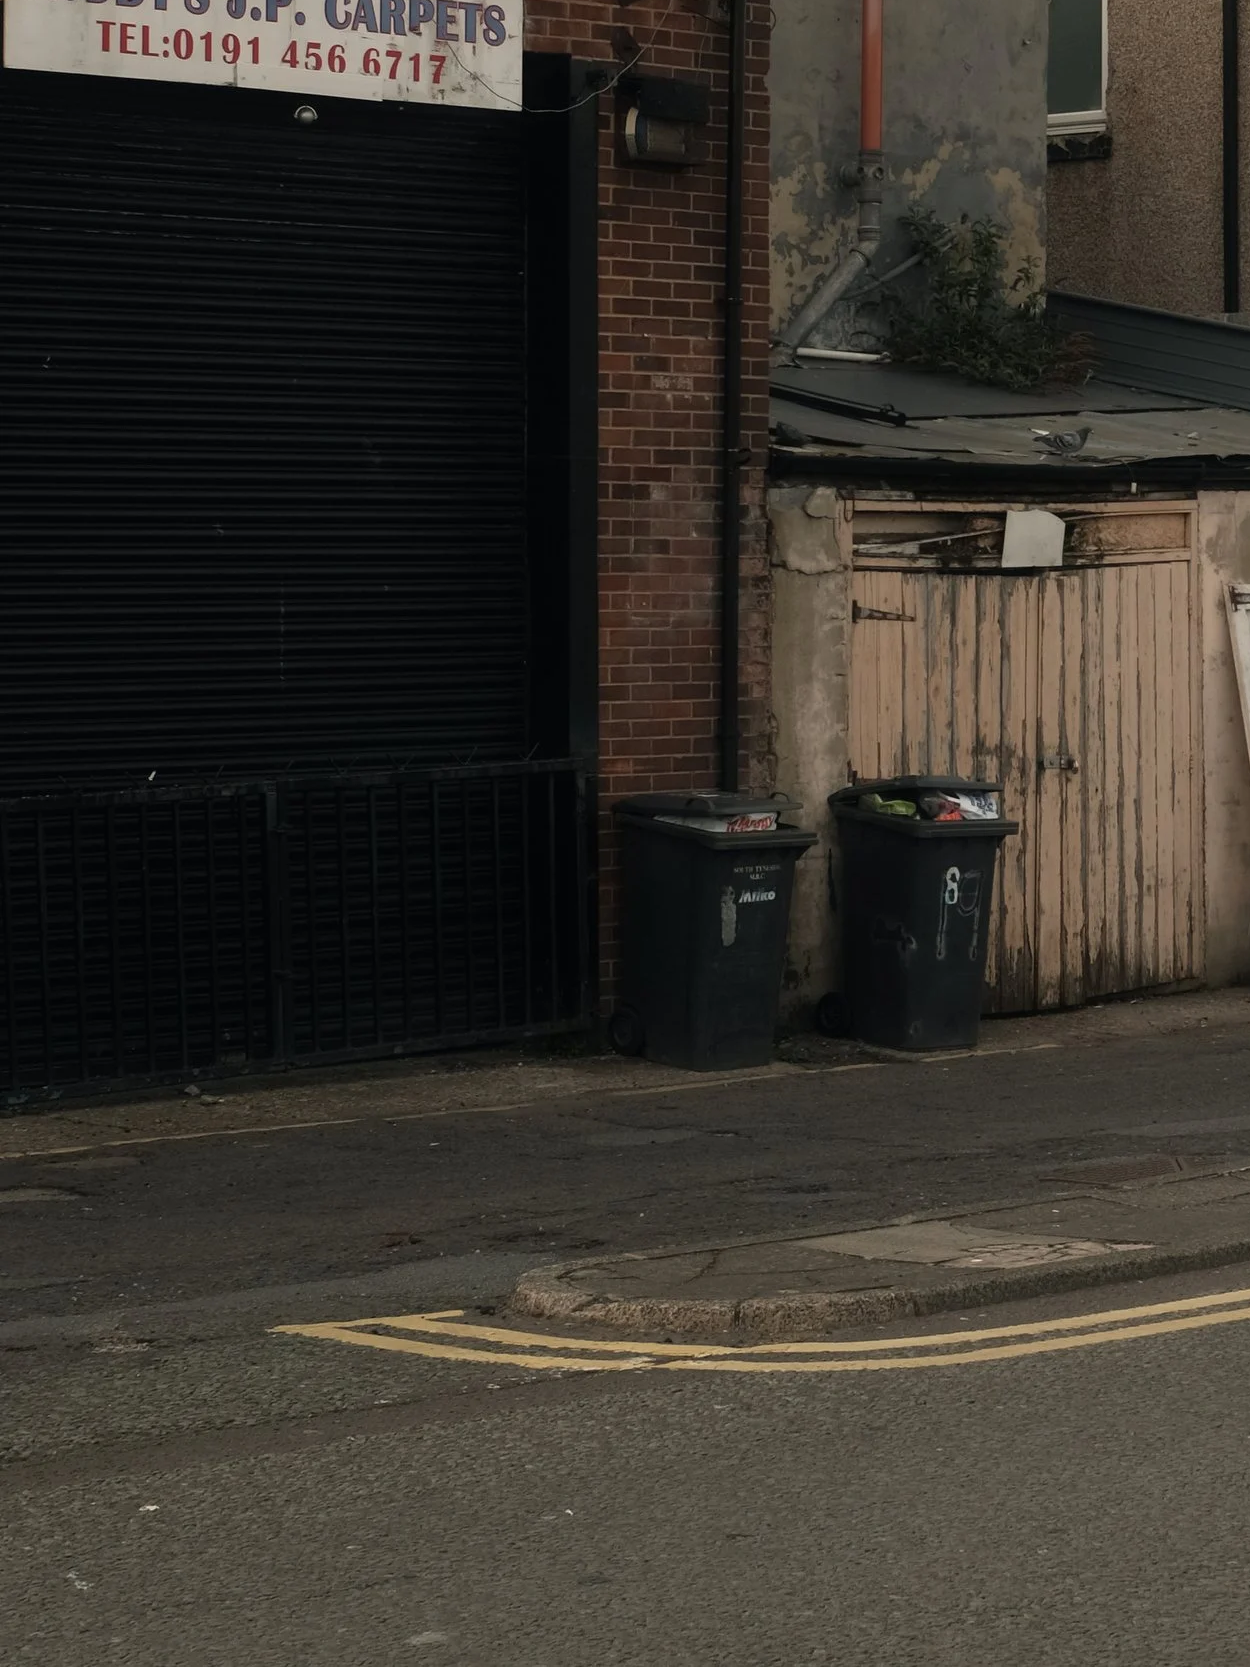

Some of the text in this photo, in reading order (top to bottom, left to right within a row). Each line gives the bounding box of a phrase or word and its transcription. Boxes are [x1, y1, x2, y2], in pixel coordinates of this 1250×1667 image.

[96, 20, 447, 84] TEL:0191 456 6717
